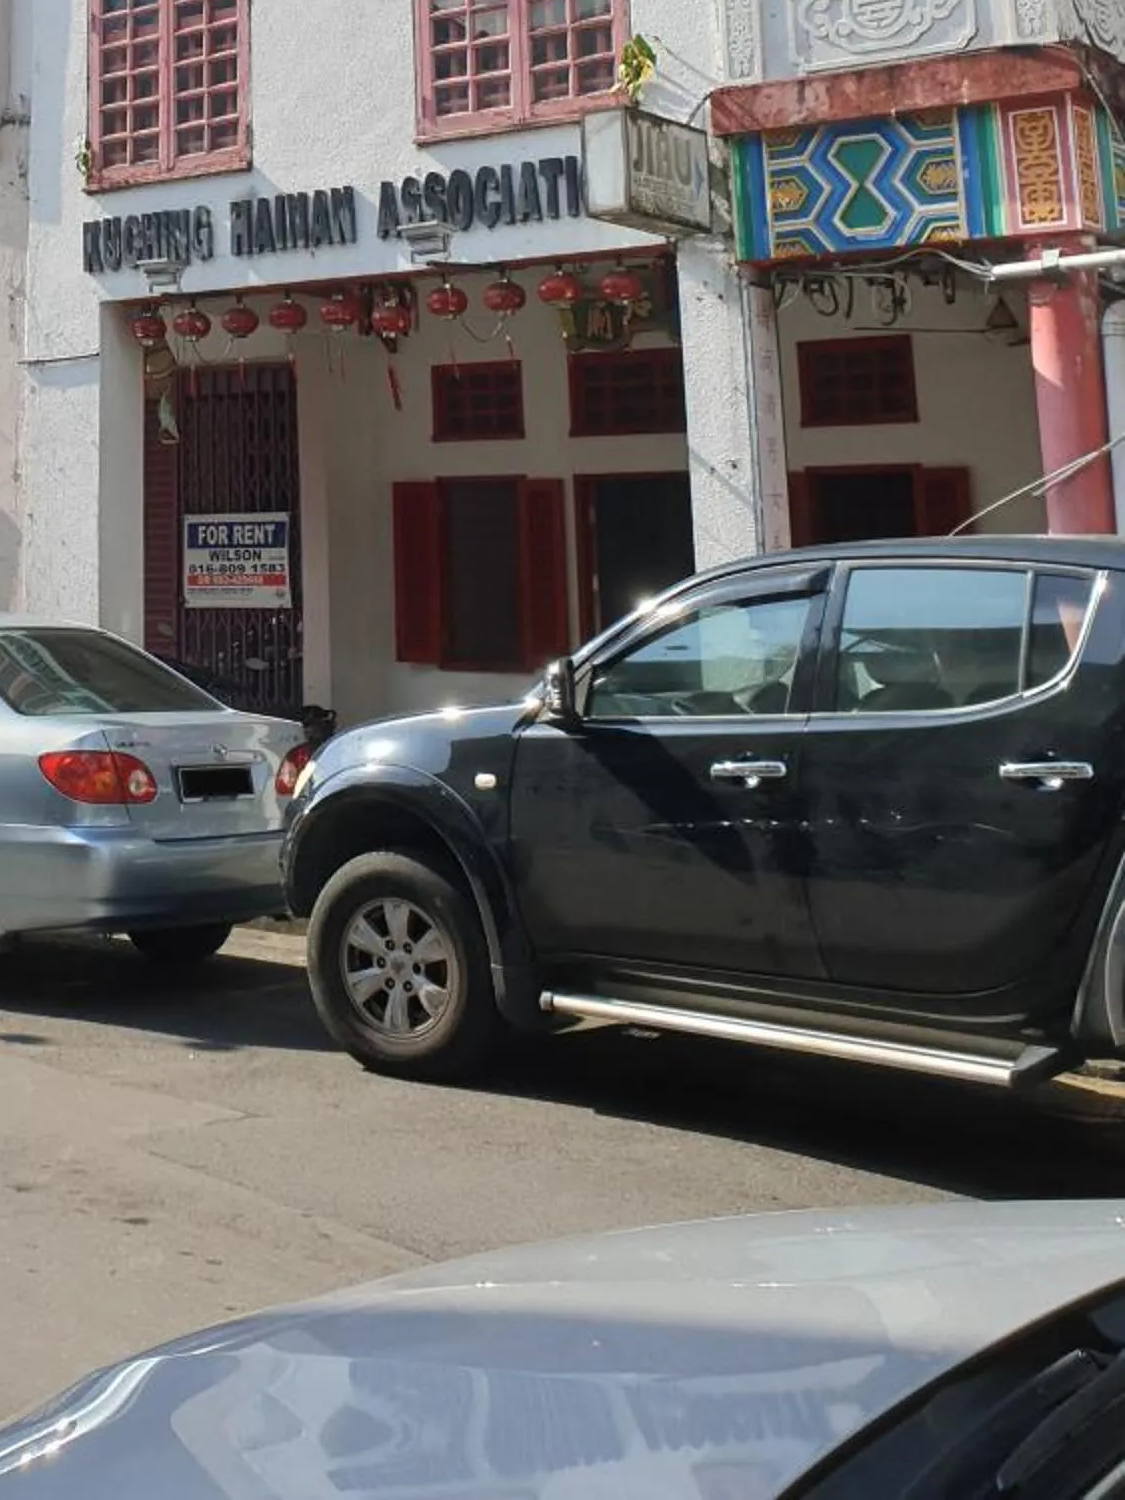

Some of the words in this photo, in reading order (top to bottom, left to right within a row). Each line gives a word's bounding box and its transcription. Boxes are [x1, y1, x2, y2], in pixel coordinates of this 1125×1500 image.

[82, 205, 214, 274] KUCHING
[230, 186, 357, 256] HAINAN
[376, 156, 581, 240] ASSOCIATI
[198, 524, 228, 546] FOR
[232, 523, 276, 545] RENT
[208, 549, 262, 562] WILSON
